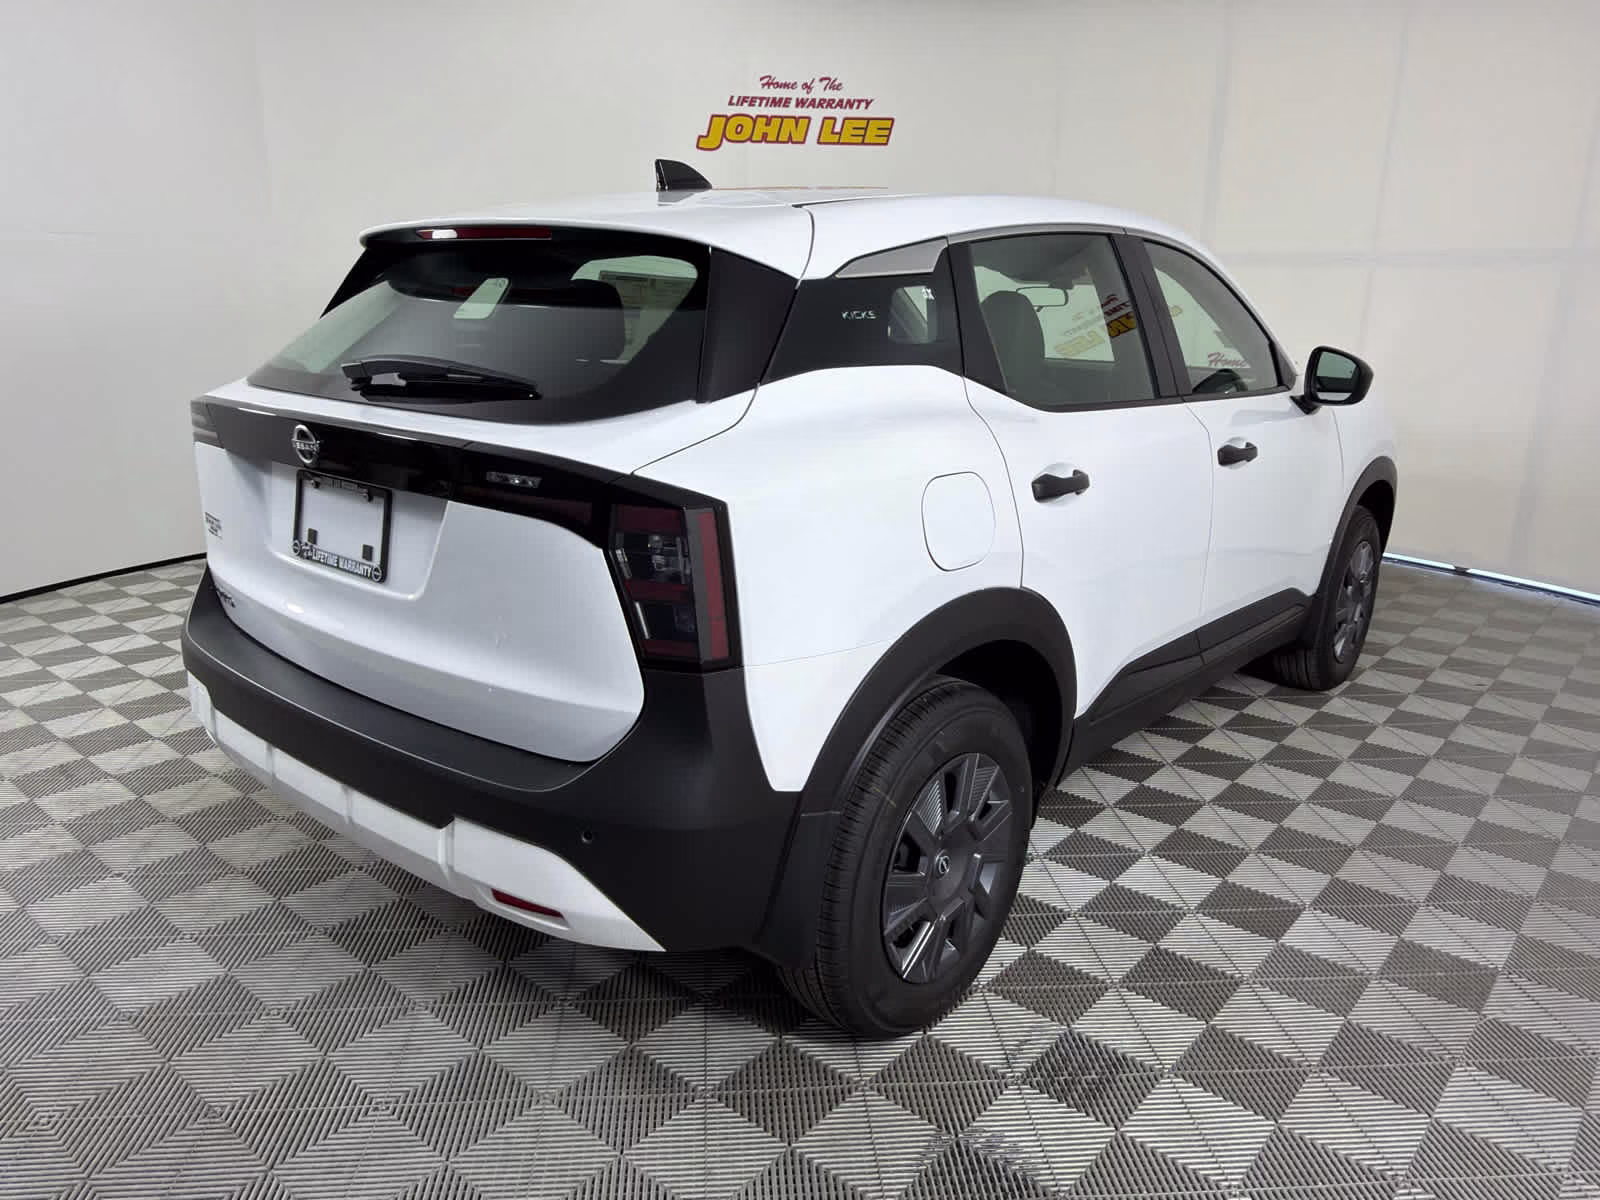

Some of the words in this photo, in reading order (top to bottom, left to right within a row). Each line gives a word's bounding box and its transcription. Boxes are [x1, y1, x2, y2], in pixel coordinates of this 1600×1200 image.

[760, 75, 798, 90] Home
[801, 77, 815, 94] of
[819, 77, 843, 91] The
[728, 96, 792, 108] LIFETIME
[795, 97, 874, 110] WARRANTY
[696, 114, 811, 151] JOHN
[817, 116, 894, 146] LEE
[841, 310, 877, 320] KICKS
[311, 548, 338, 567] LIFETIME
[338, 556, 372, 578] WARRANTY
